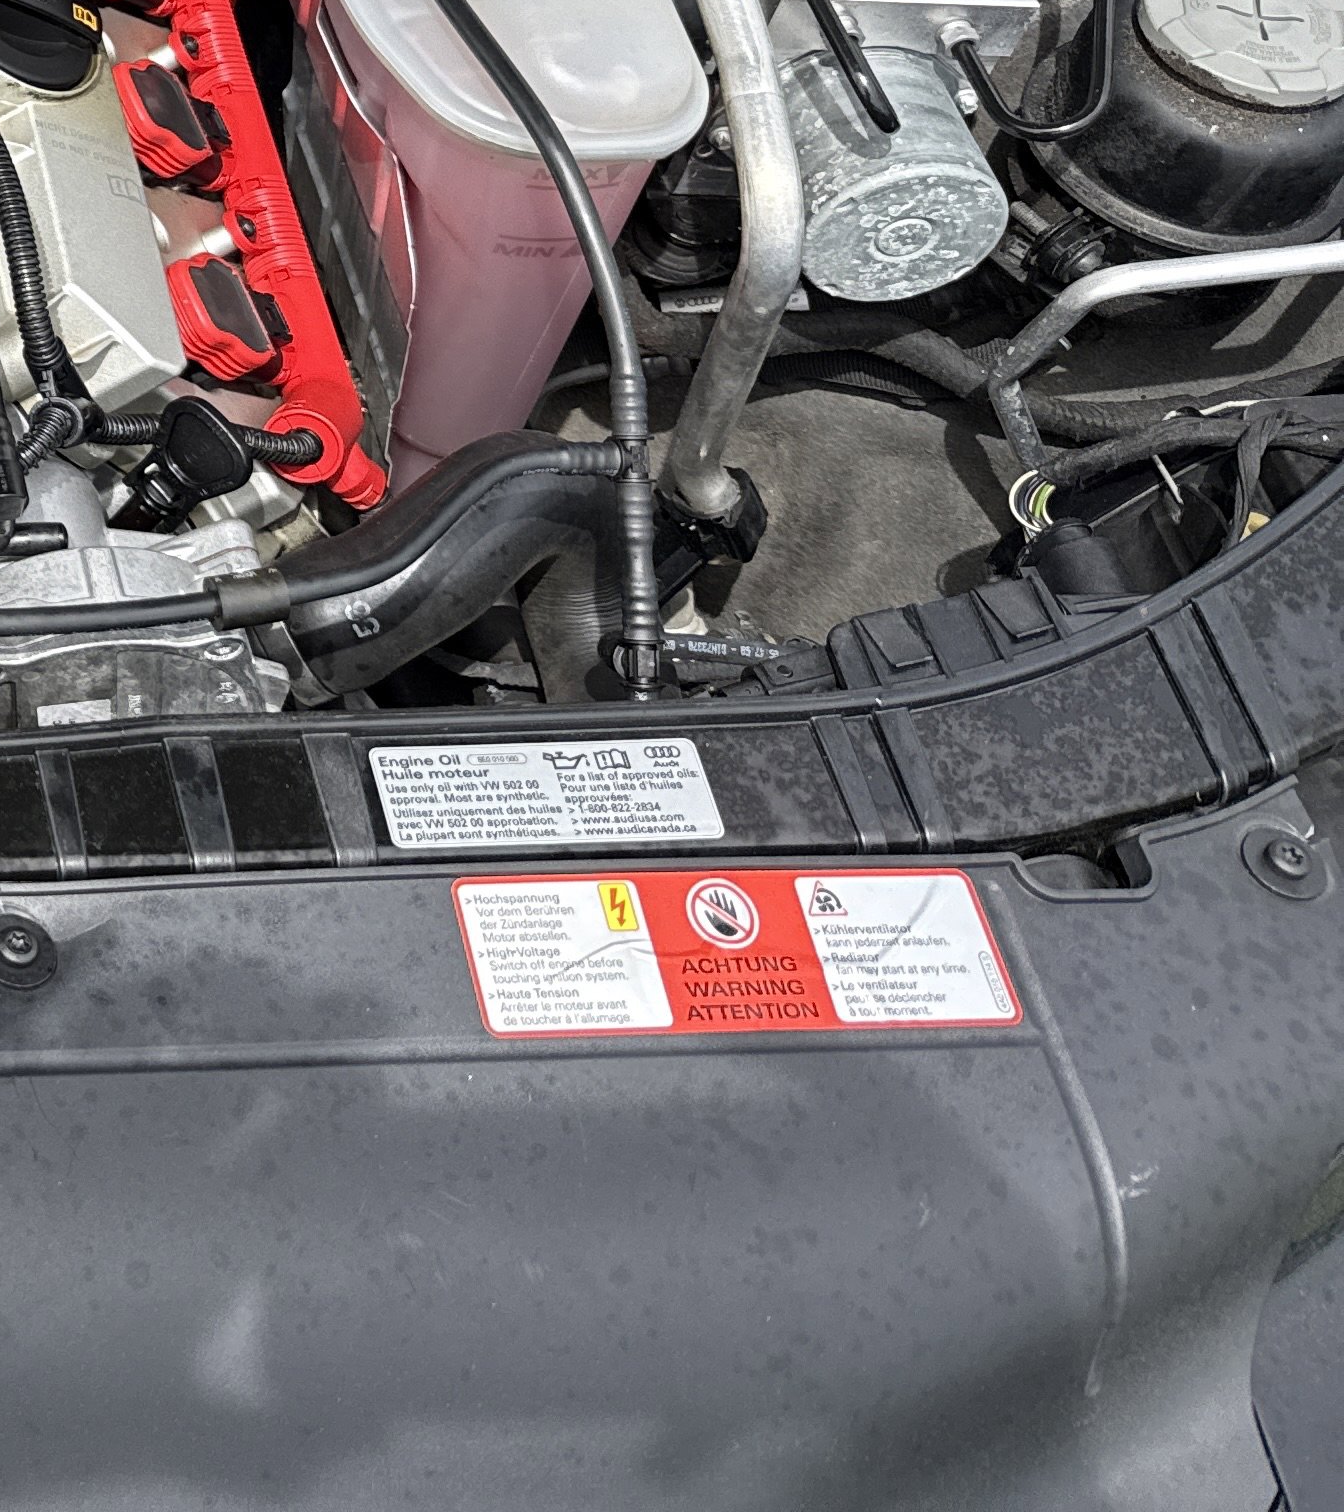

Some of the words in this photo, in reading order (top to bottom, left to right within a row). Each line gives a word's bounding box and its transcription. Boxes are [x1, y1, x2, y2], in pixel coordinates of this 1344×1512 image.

[532, 167, 603, 181] MX
[492, 242, 555, 258] MIN
[378, 755, 434, 769] Engine
[439, 754, 461, 766] Oil
[381, 769, 423, 781] Huile
[429, 768, 489, 779] moteur
[557, 773, 575, 782] For
[588, 772, 605, 781] list
[608, 772, 619, 780] of
[622, 769, 673, 782] approved
[677, 769, 700, 778] oils:
[385, 784, 407, 794] Use
[411, 783, 434, 796] only
[438, 782, 451, 792] oil
[454, 781, 478, 792] with
[480, 781, 499, 790] VW
[503, 780, 522, 789] 502
[526, 779, 539, 789] 00
[560, 783, 587, 793] Pour
[590, 784, 610, 792] une
[613, 782, 636, 790] liste
[639, 781, 683, 790] d'huiles
[390, 794, 442, 806] approval.
[444, 793, 473, 803] Most
[476, 794, 493, 802] are
[496, 791, 549, 803] synthetic.
[393, 807, 434, 818] Utilisez
[437, 806, 503, 820] uniquement
[506, 805, 526, 814] des
[529, 803, 562, 814] huiles
[581, 812, 685, 824] www.audiusa.com
[397, 821, 423, 830] avec
[424, 818, 443, 828] VW
[448, 818, 467, 827] 502
[470, 817, 483, 826] 00
[487, 815, 558, 829] approbation.
[399, 831, 412, 841] La
[416, 830, 456, 842] plupart
[459, 829, 483, 839] sont
[486, 826, 560, 840] synthétiques.
[584, 824, 697, 836] www.audicanada.ca
[473, 894, 560, 906] Hochspannung
[475, 907, 494, 917] Vor
[498, 906, 522, 916] dem
[524, 905, 574, 916] Berühren
[480, 919, 498, 930] der
[500, 918, 562, 930] Zündanlage
[822, 924, 911, 935] Kühlerventilator
[482, 932, 516, 943] Motor
[519, 931, 571, 942] abstellen.
[826, 937, 852, 948] kann
[902, 936, 950, 947] anlaufen.
[831, 952, 880, 963] Radiator
[490, 960, 527, 971] Switch
[530, 959, 545, 970] off
[587, 958, 623, 968] before
[681, 956, 798, 975] ACHTUNG
[836, 965, 853, 975] fan
[856, 965, 879, 976] may
[882, 963, 906, 974] start
[908, 963, 918, 973] at
[921, 964, 940, 975] any
[942, 962, 970, 973] time.
[493, 973, 541, 985] touching
[586, 971, 629, 983] system.
[684, 979, 805, 997] WARNING
[841, 980, 854, 991] Le
[857, 979, 917, 990] ventilateur
[497, 989, 531, 999] Haute
[533, 988, 579, 999] Tension
[873, 994, 886, 1003] se
[501, 1002, 538, 1013] Arrêter
[541, 1002, 551, 1011] le
[554, 1001, 594, 1011] moteur
[597, 1000, 627, 1010] avant
[687, 1002, 820, 1021] ATTENTION
[503, 1015, 517, 1025] de
[521, 1014, 561, 1025] toucher
